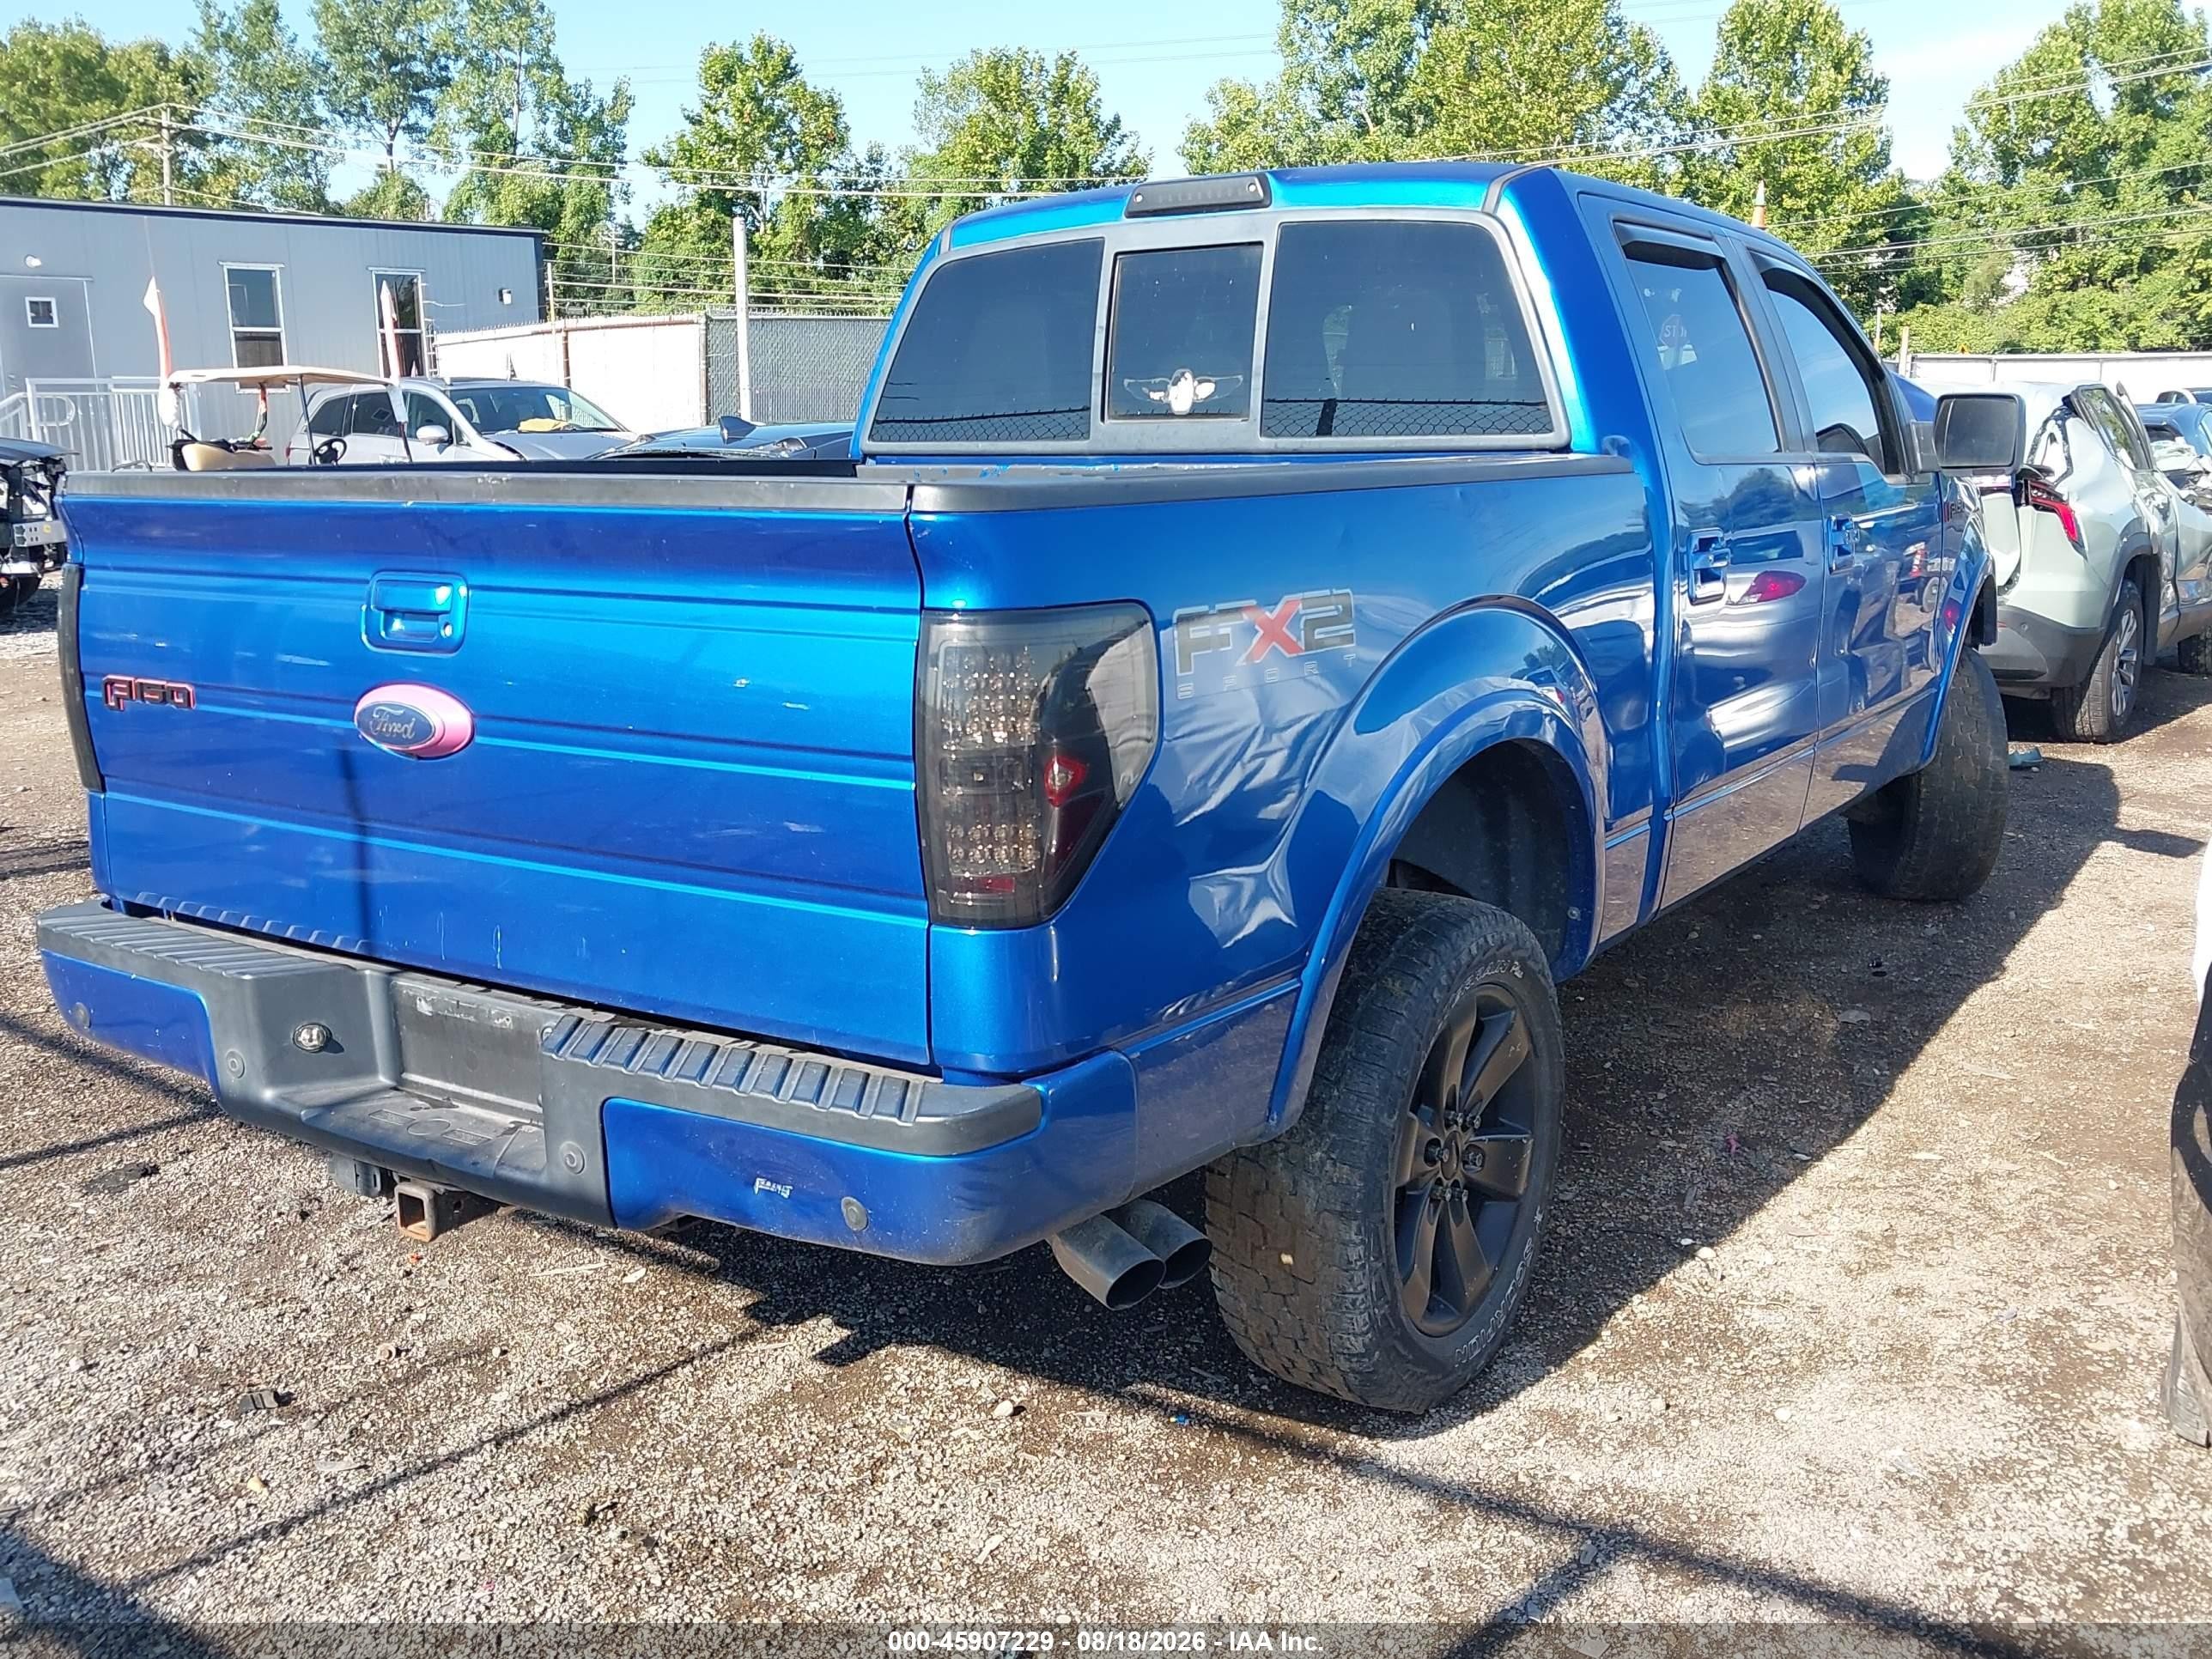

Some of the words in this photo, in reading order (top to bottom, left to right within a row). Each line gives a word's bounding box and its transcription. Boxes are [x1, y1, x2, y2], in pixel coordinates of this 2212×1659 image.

[1173, 588, 1357, 677] FX2
[1176, 653, 1357, 701] SPORT
[369, 705, 417, 740] Ford
